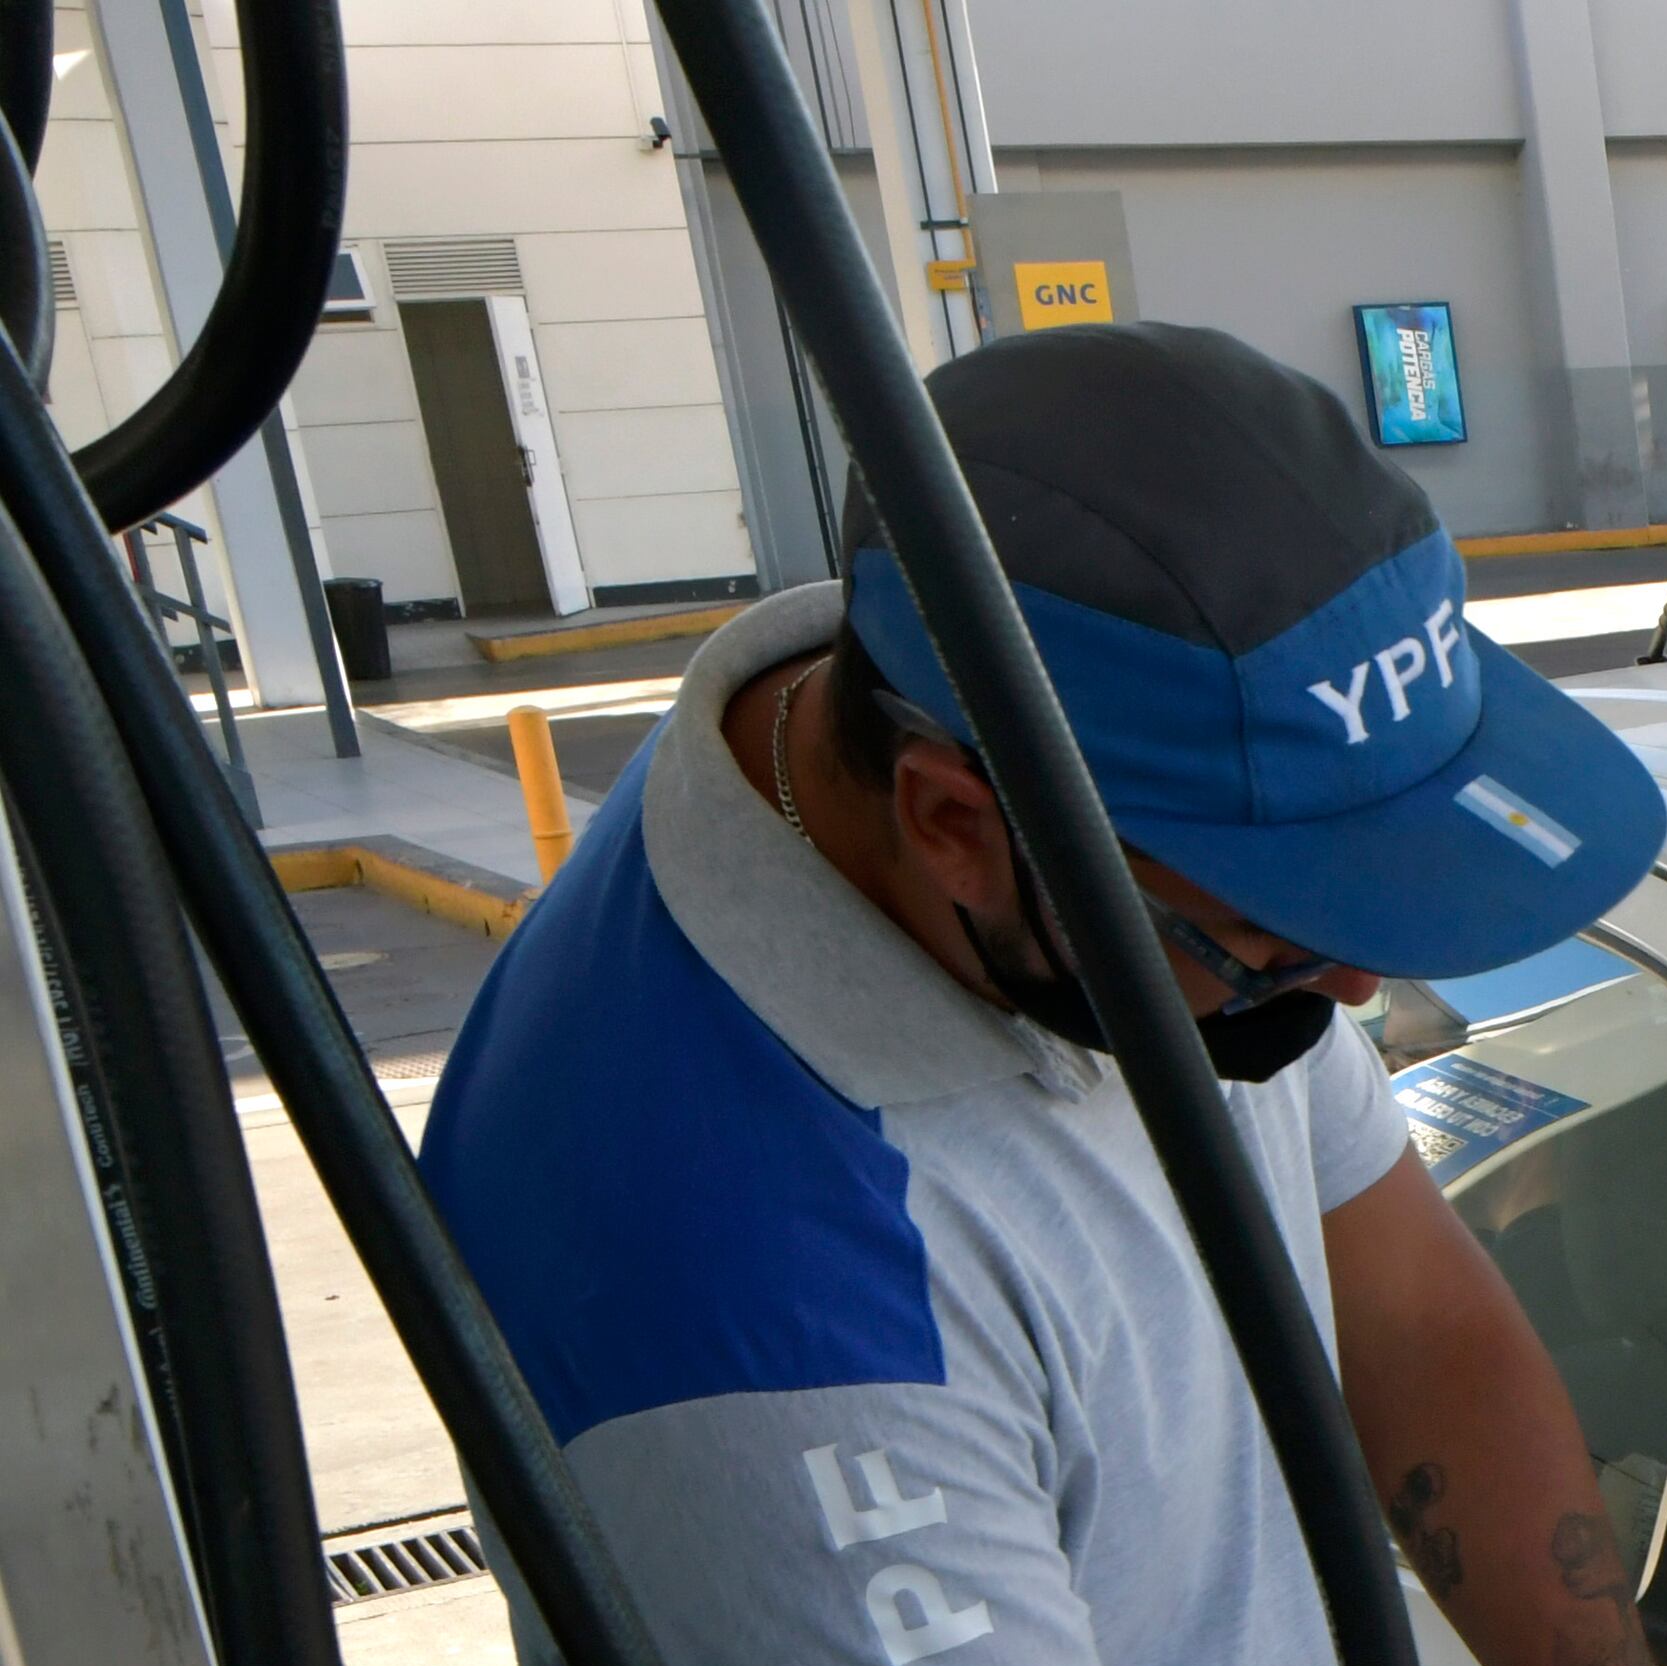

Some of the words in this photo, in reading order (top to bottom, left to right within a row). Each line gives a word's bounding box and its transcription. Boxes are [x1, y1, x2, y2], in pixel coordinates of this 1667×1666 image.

[1035, 283, 1098, 306] GNC
[1396, 328, 1427, 421] POTENCIA
[1414, 330, 1436, 391] CARGAS
[1306, 598, 1461, 745] YPF
[107, 1200, 158, 1310] Continental
